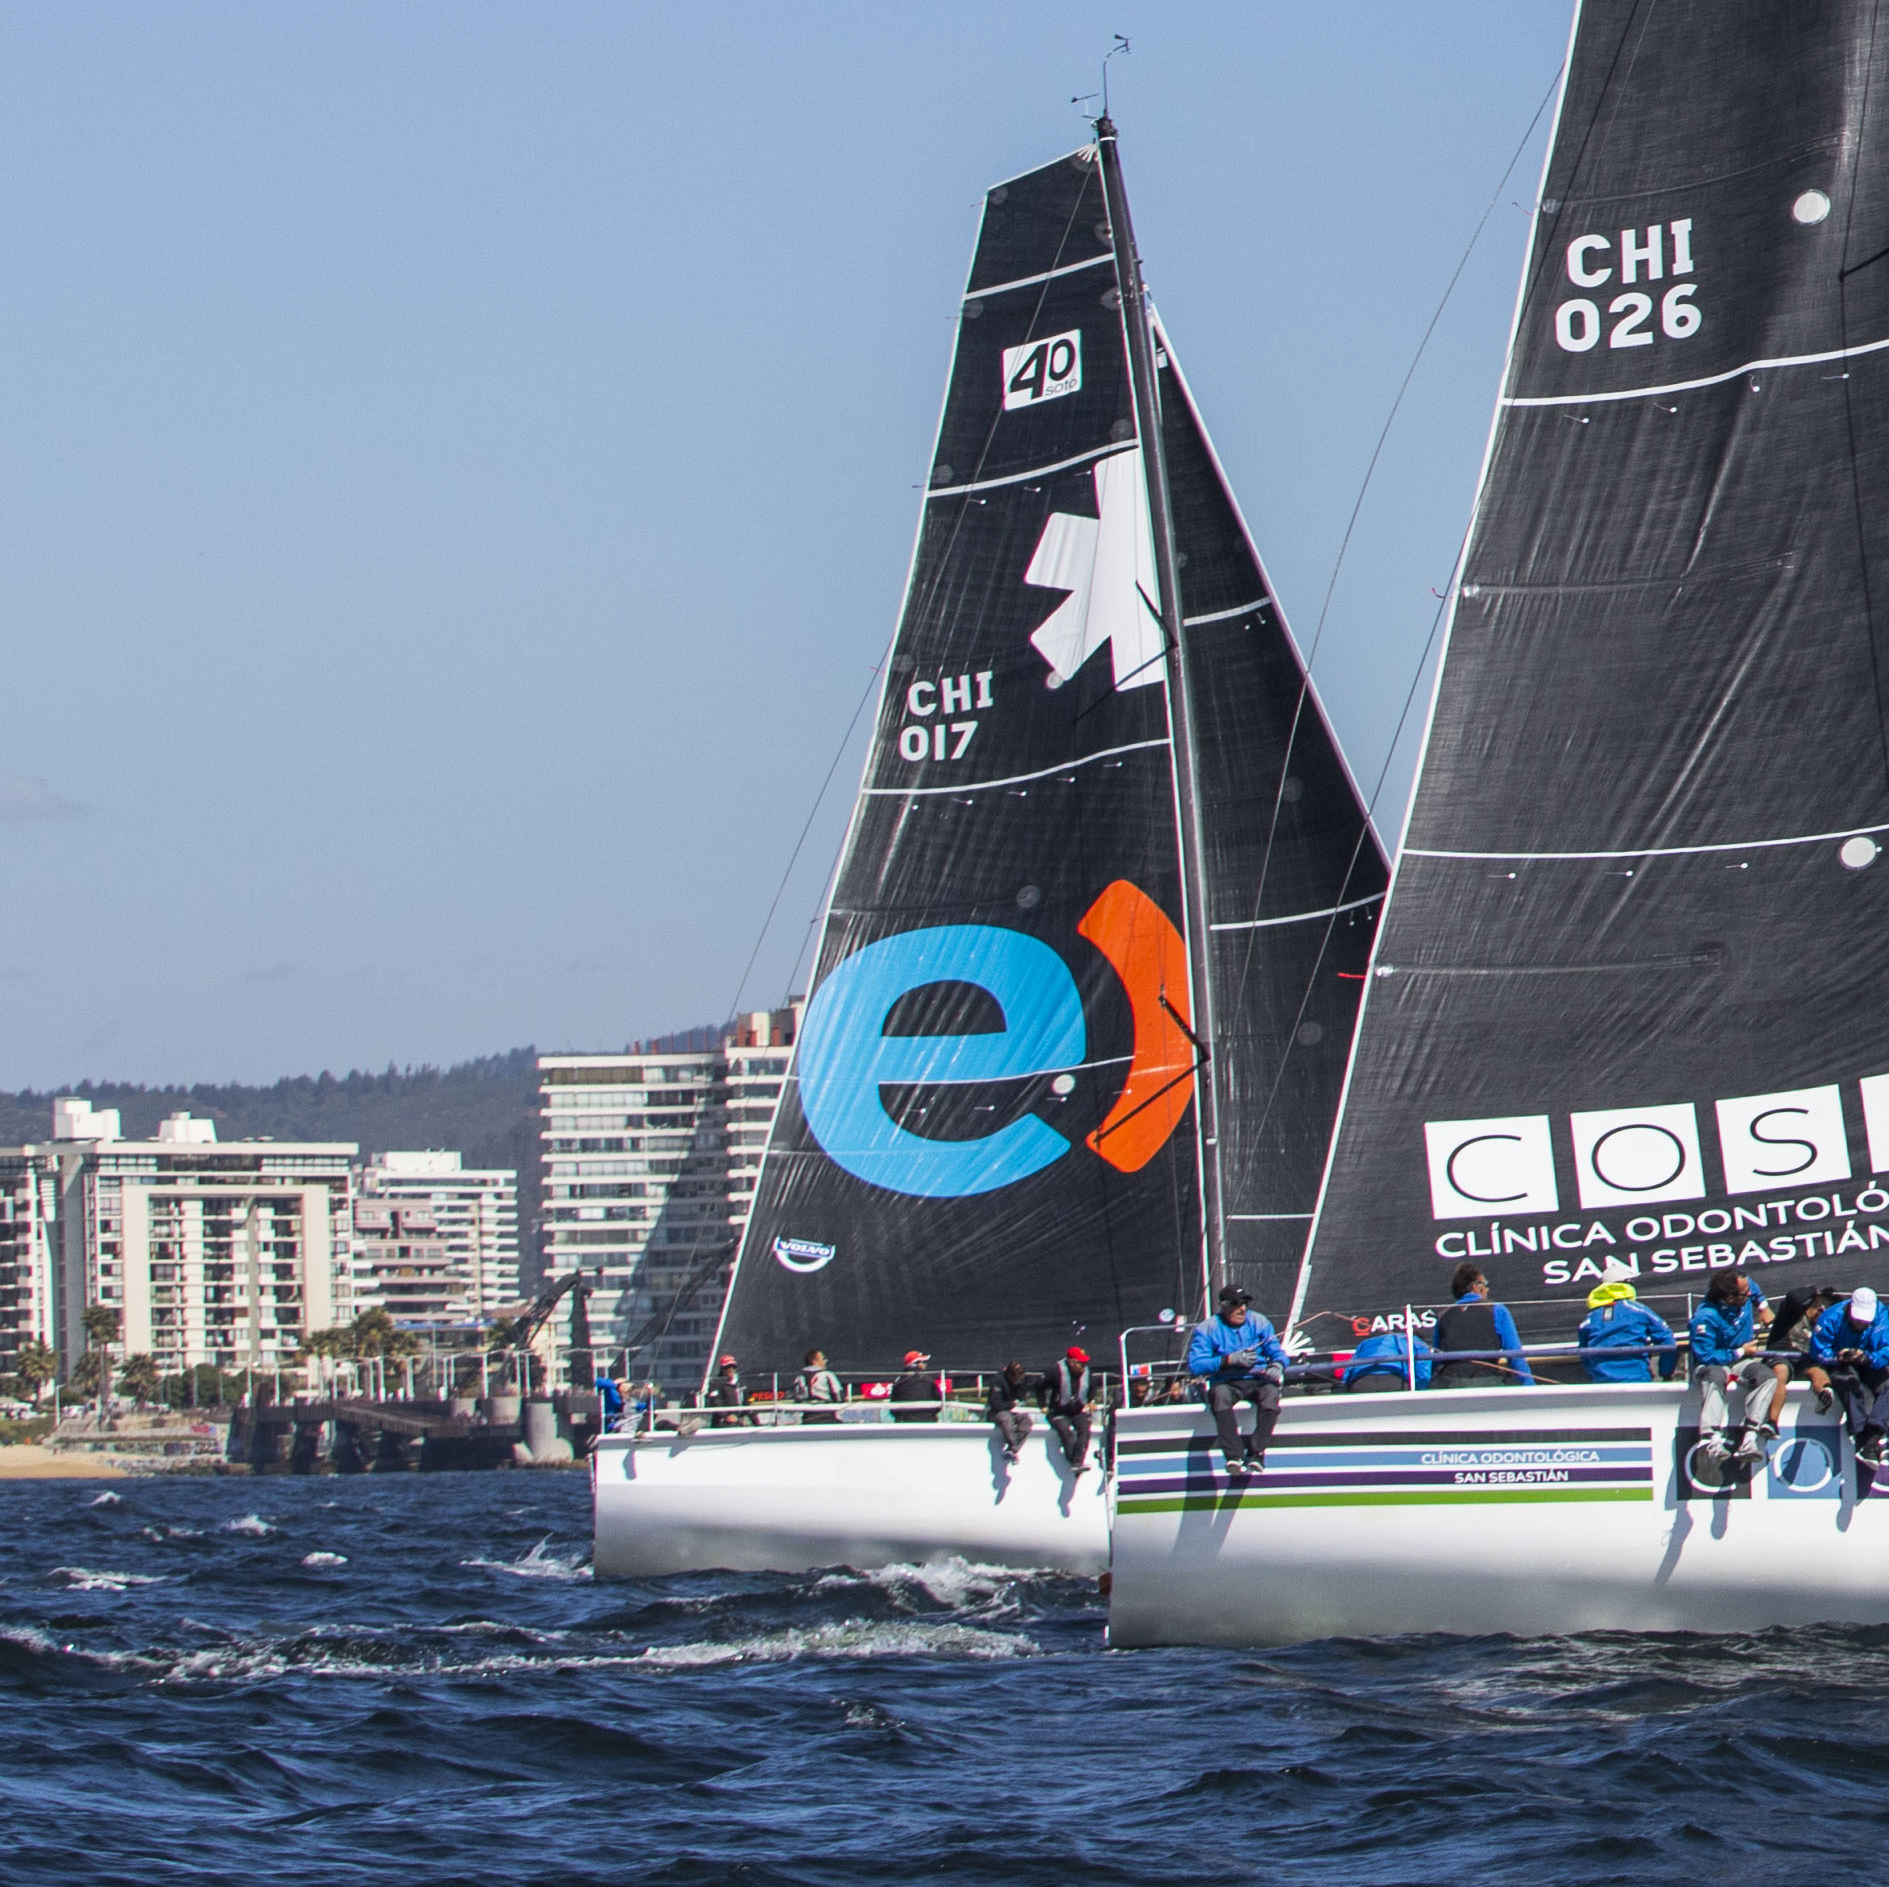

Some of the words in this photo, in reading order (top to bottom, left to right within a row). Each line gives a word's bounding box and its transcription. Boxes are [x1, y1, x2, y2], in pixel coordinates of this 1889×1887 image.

[1567, 218, 1694, 288] CHI
[1555, 283, 1702, 352] 026
[1008, 338, 1076, 400] 40
[907, 670, 994, 717] CHI
[899, 720, 979, 762] 017
[780, 1241, 831, 1256] VOLVO
[1435, 1221, 1617, 1258] CLÍNICA
[1543, 1252, 1640, 1284] SAN
[1421, 1451, 1478, 1464] CLÍNICA
[1480, 1449, 1600, 1464] ODONTOLÓGICA
[1454, 1472, 1486, 1483] SAN
[1488, 1468, 1569, 1482] SEBASTIÁN
